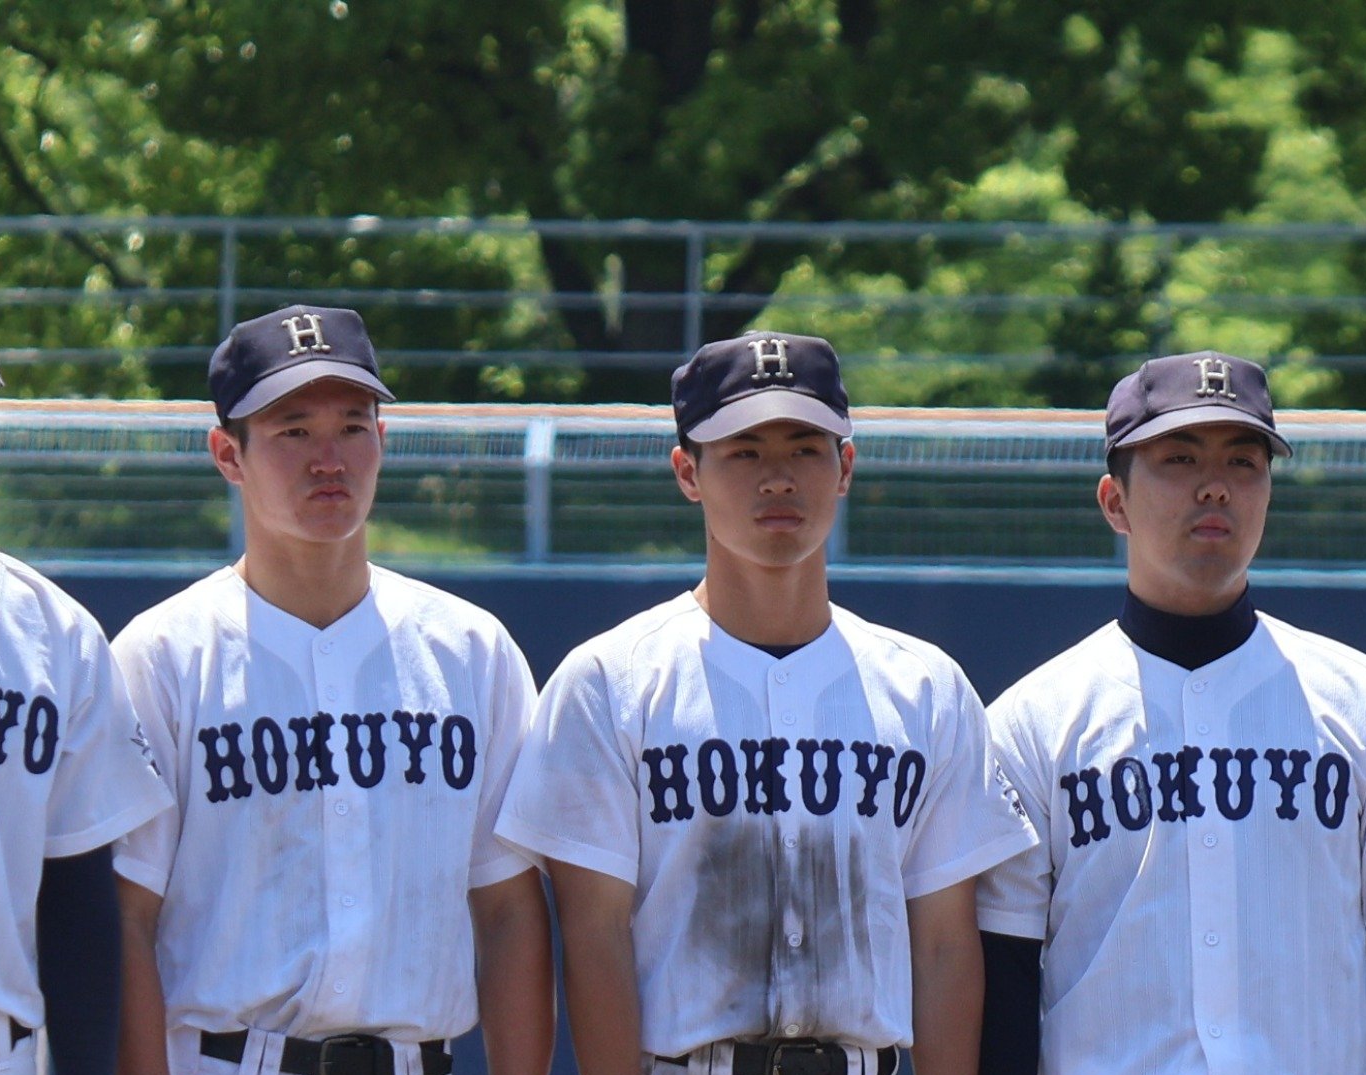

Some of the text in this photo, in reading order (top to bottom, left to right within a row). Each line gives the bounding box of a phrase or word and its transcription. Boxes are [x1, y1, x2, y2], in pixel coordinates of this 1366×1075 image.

[281, 314, 331, 356] H
[748, 339, 794, 380] H
[1192, 358, 1237, 400] H
[198, 710, 477, 804] HOKUYO
[642, 737, 926, 828] HOKUYO
[1060, 745, 1350, 848] HOKUYO
